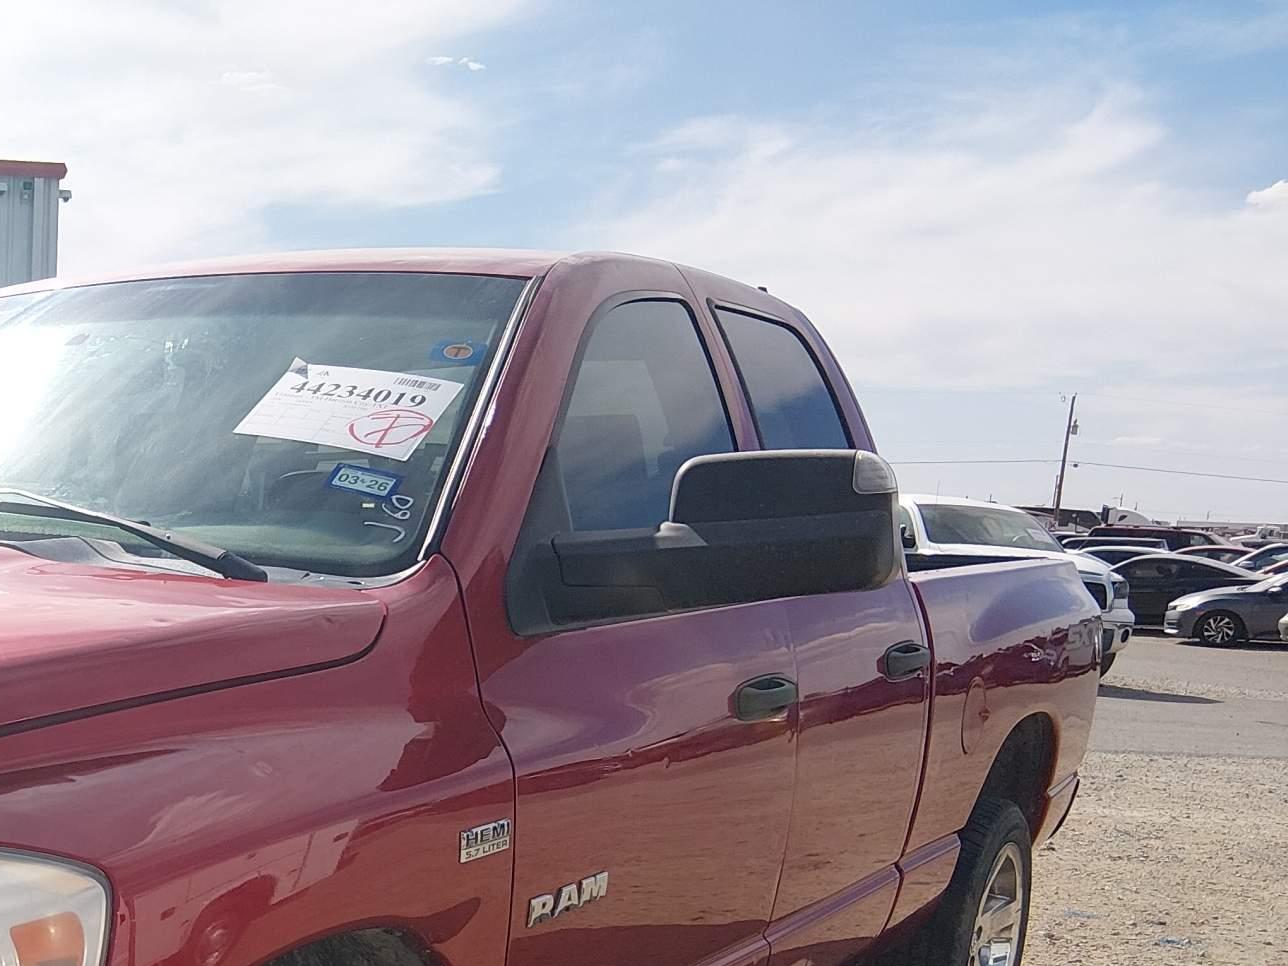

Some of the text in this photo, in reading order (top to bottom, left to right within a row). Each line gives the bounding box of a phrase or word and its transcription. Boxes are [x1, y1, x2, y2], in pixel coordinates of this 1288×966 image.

[290, 380, 427, 407] 44234019
[365, 479, 390, 492] 26
[466, 821, 510, 848] HEMI
[465, 839, 508, 860] 5.7 LITER
[526, 871, 608, 928] RAM
